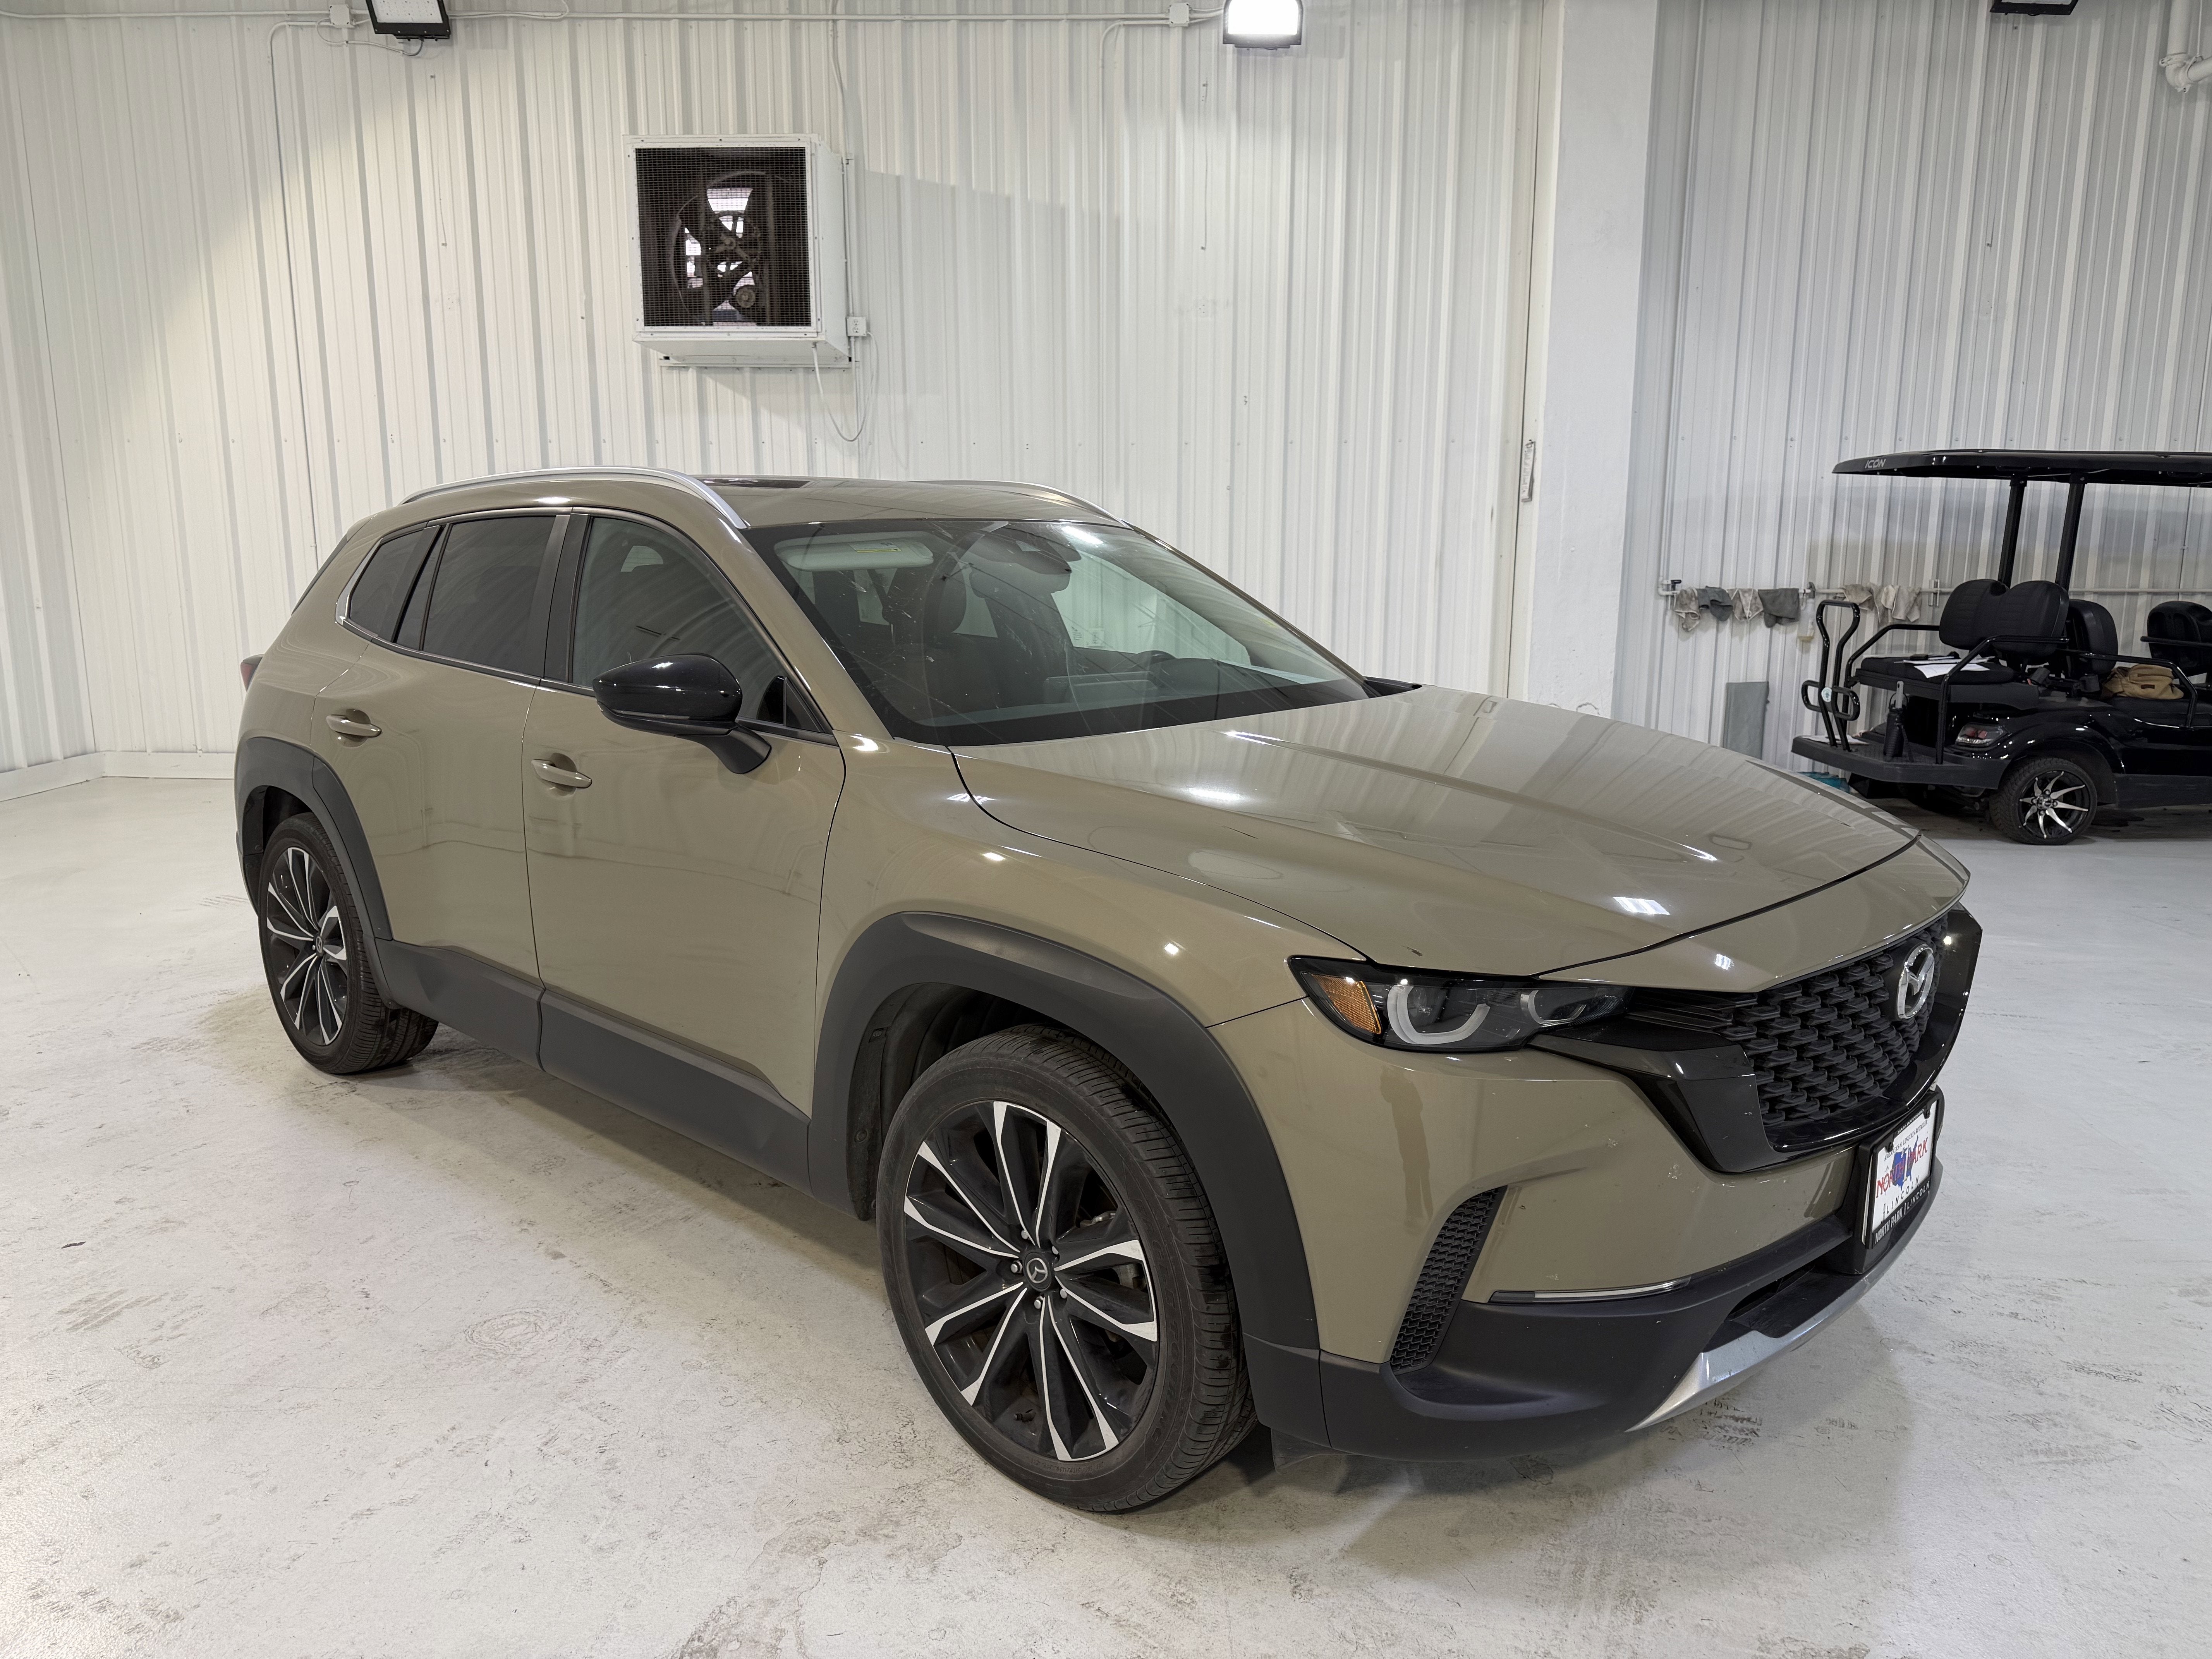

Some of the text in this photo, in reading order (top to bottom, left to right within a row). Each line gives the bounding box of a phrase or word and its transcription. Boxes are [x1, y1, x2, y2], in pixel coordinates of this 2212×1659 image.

[1865, 459, 1886, 469] ICON
[1876, 1137, 1928, 1198] NORTH PARK
[1875, 1181, 1930, 1244] NORTH PARK LINCOLN
[1887, 1175, 1919, 1214] LINCOLN
